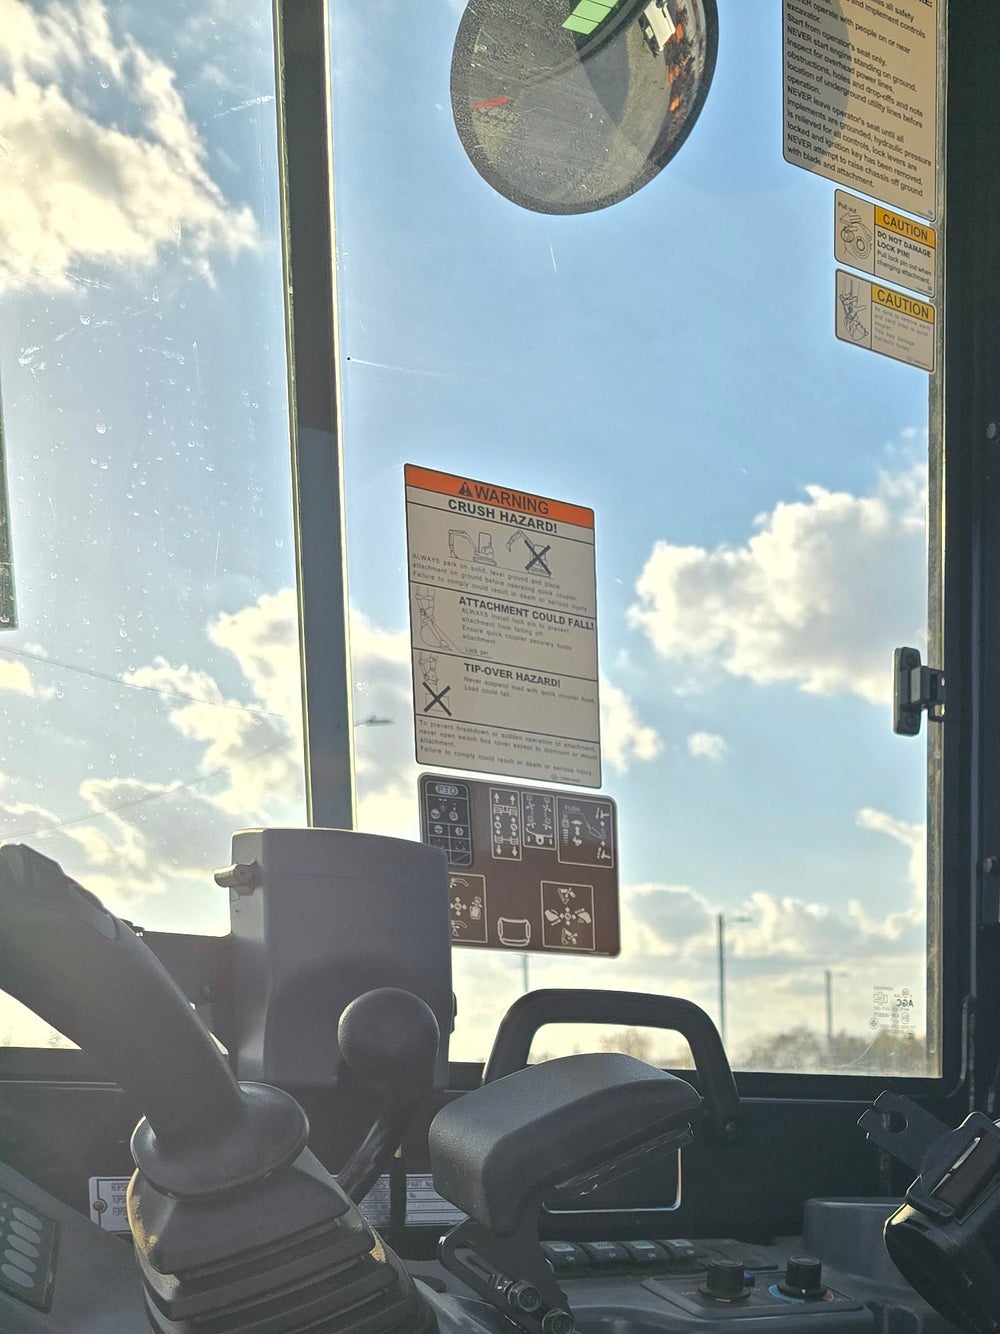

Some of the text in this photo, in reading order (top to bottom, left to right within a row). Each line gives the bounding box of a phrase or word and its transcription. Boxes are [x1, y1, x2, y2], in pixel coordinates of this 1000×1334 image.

[787, 2, 822, 25] excavator.
[814, 4, 911, 55] operate with people on or near
[787, 13, 887, 68] Start from operator's seat only.
[787, 25, 918, 93] NEVER start engine standing on ground.
[787, 37, 895, 94] Inspect for overhead power lines.
[787, 51, 923, 118] obstructions, holes and drop-offs and note
[787, 75, 822, 95] operation.
[787, 62, 923, 129] location of underground utility lines before
[787, 85, 904, 143] NEVER leave operator's seat until all
[823, 125, 833, 136] for
[872, 146, 886, 159] lock
[907, 162, 917, 172] are
[827, 116, 838, 126] are
[905, 150, 931, 167] pressure
[787, 148, 874, 188] with blade and attachment.
[878, 231, 931, 258] DO NOT DAMAGE
[883, 213, 928, 242] CAUTION
[878, 240, 896, 253] LOCK
[878, 289, 929, 319] CAUTION
[448, 499, 557, 534] CRUSH HAZARD!
[475, 485, 549, 516] WARNING
[459, 596, 594, 631] ATTACHMENT COULD FALL!
[464, 663, 561, 688] TIP-OVER HAZARD!
